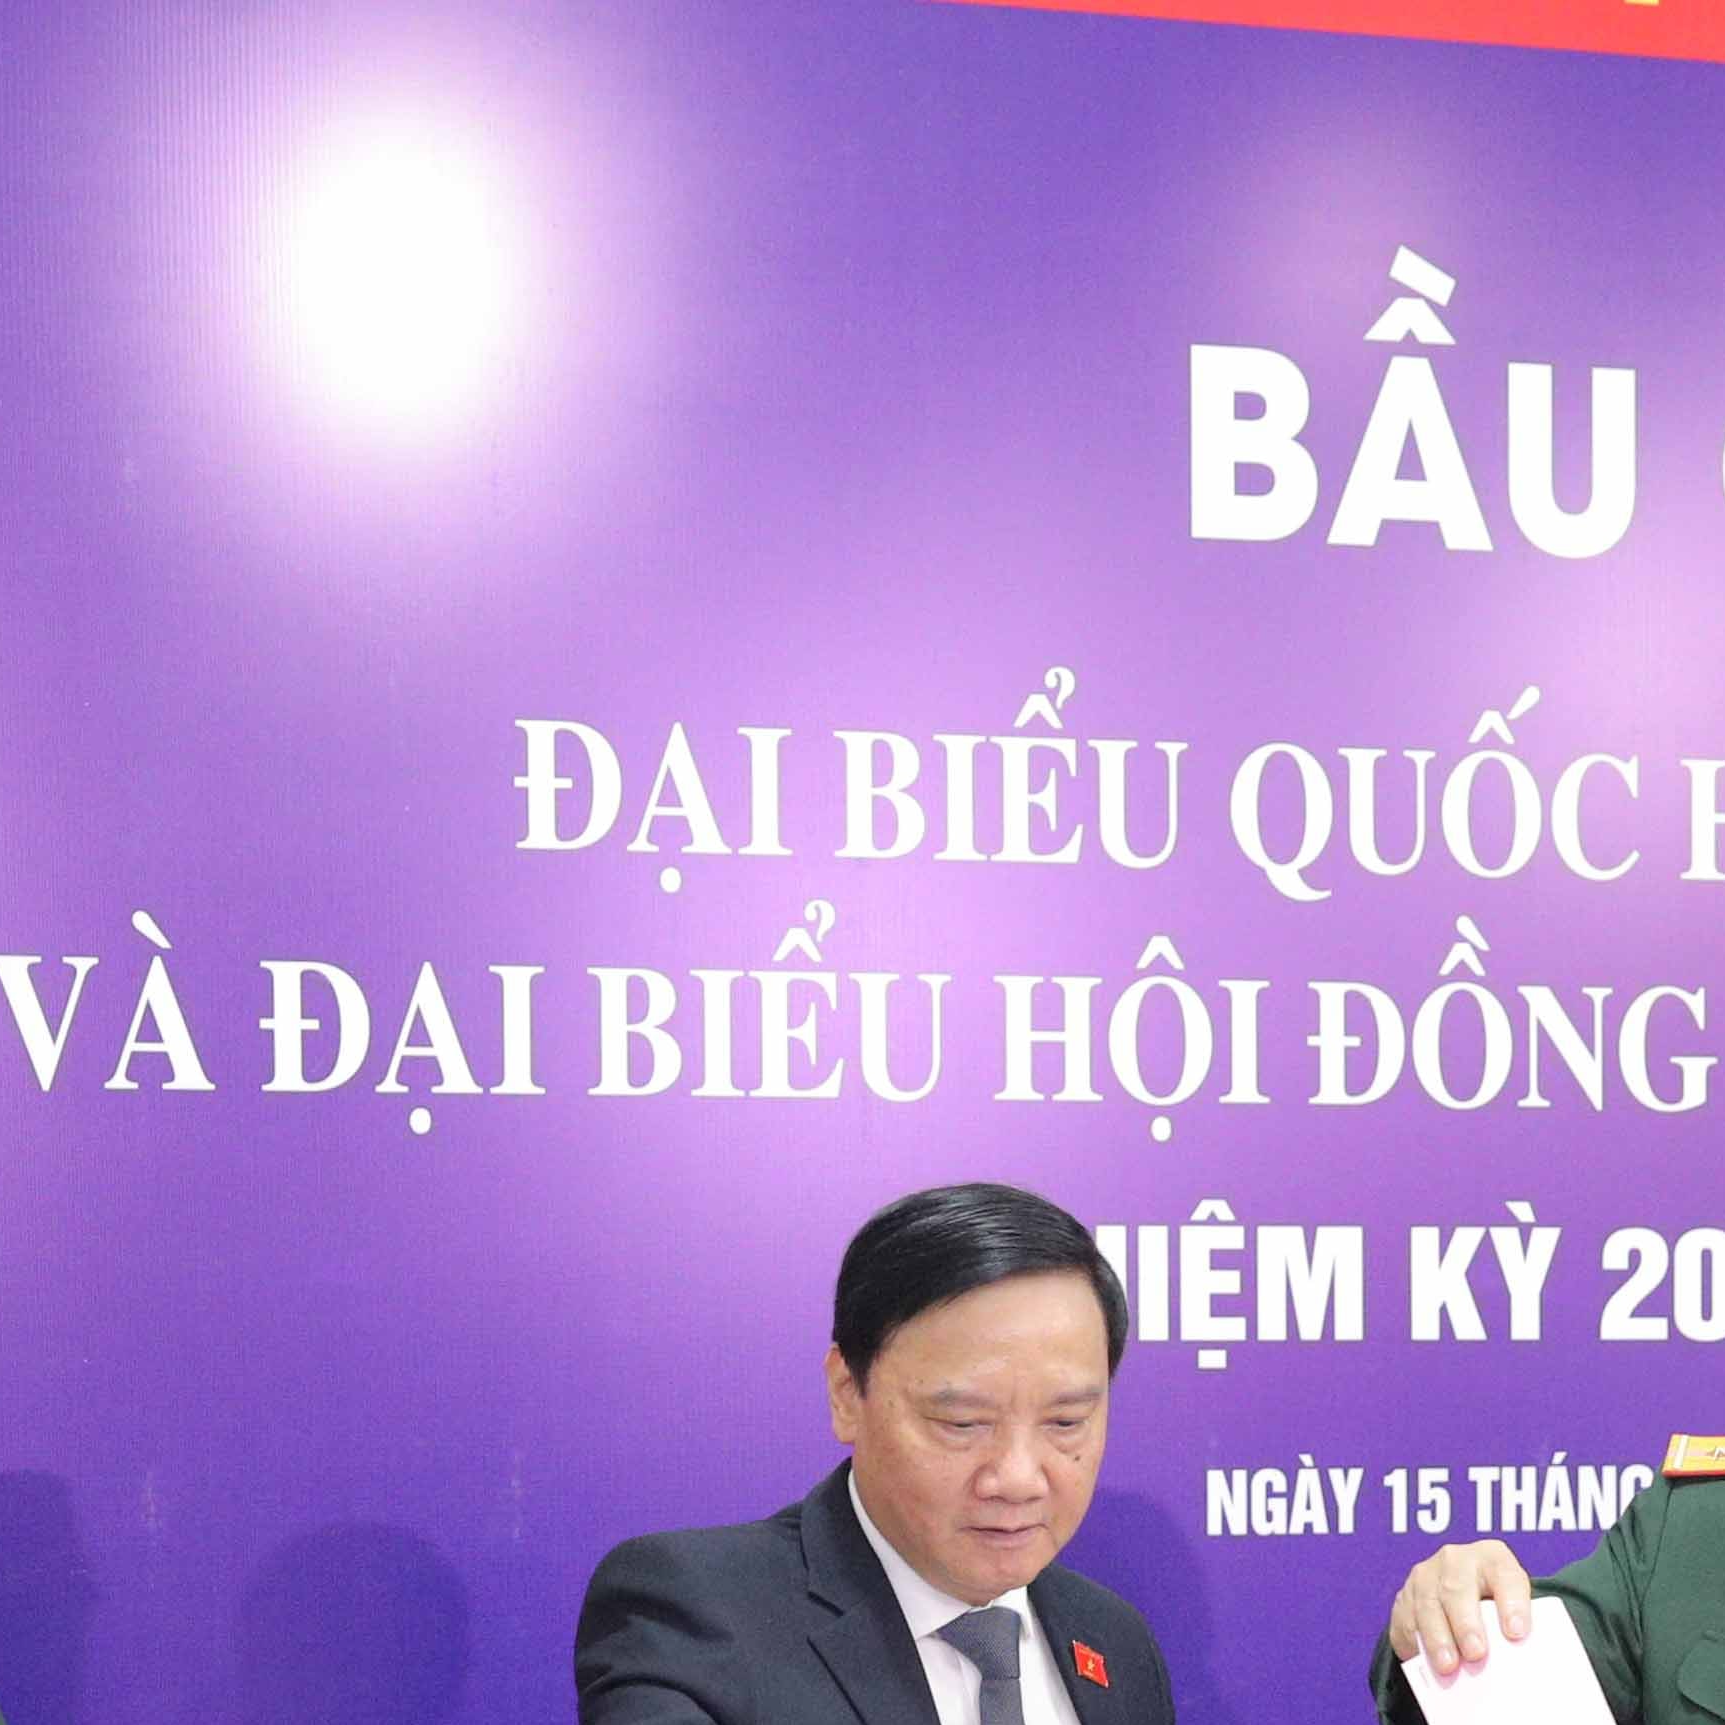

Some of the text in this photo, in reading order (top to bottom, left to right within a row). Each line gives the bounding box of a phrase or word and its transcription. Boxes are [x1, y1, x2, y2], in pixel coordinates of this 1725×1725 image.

[1189, 244, 1638, 561] BẦU
[514, 719, 794, 893] ĐẠI
[833, 666, 1188, 869] BIỂU
[1229, 685, 1641, 903] QUỐC
[259, 961, 546, 1134] ĐẠI
[586, 899, 953, 1103] BIỂU
[993, 935, 1270, 1142] HỘI
[1306, 915, 1718, 1113] ĐỒNG
[1096, 1199, 1364, 1369] IỆM
[1410, 1201, 1562, 1340] KỲ
[1206, 1454, 1364, 1535] NGÀY
[1383, 1467, 1451, 1534] 15
